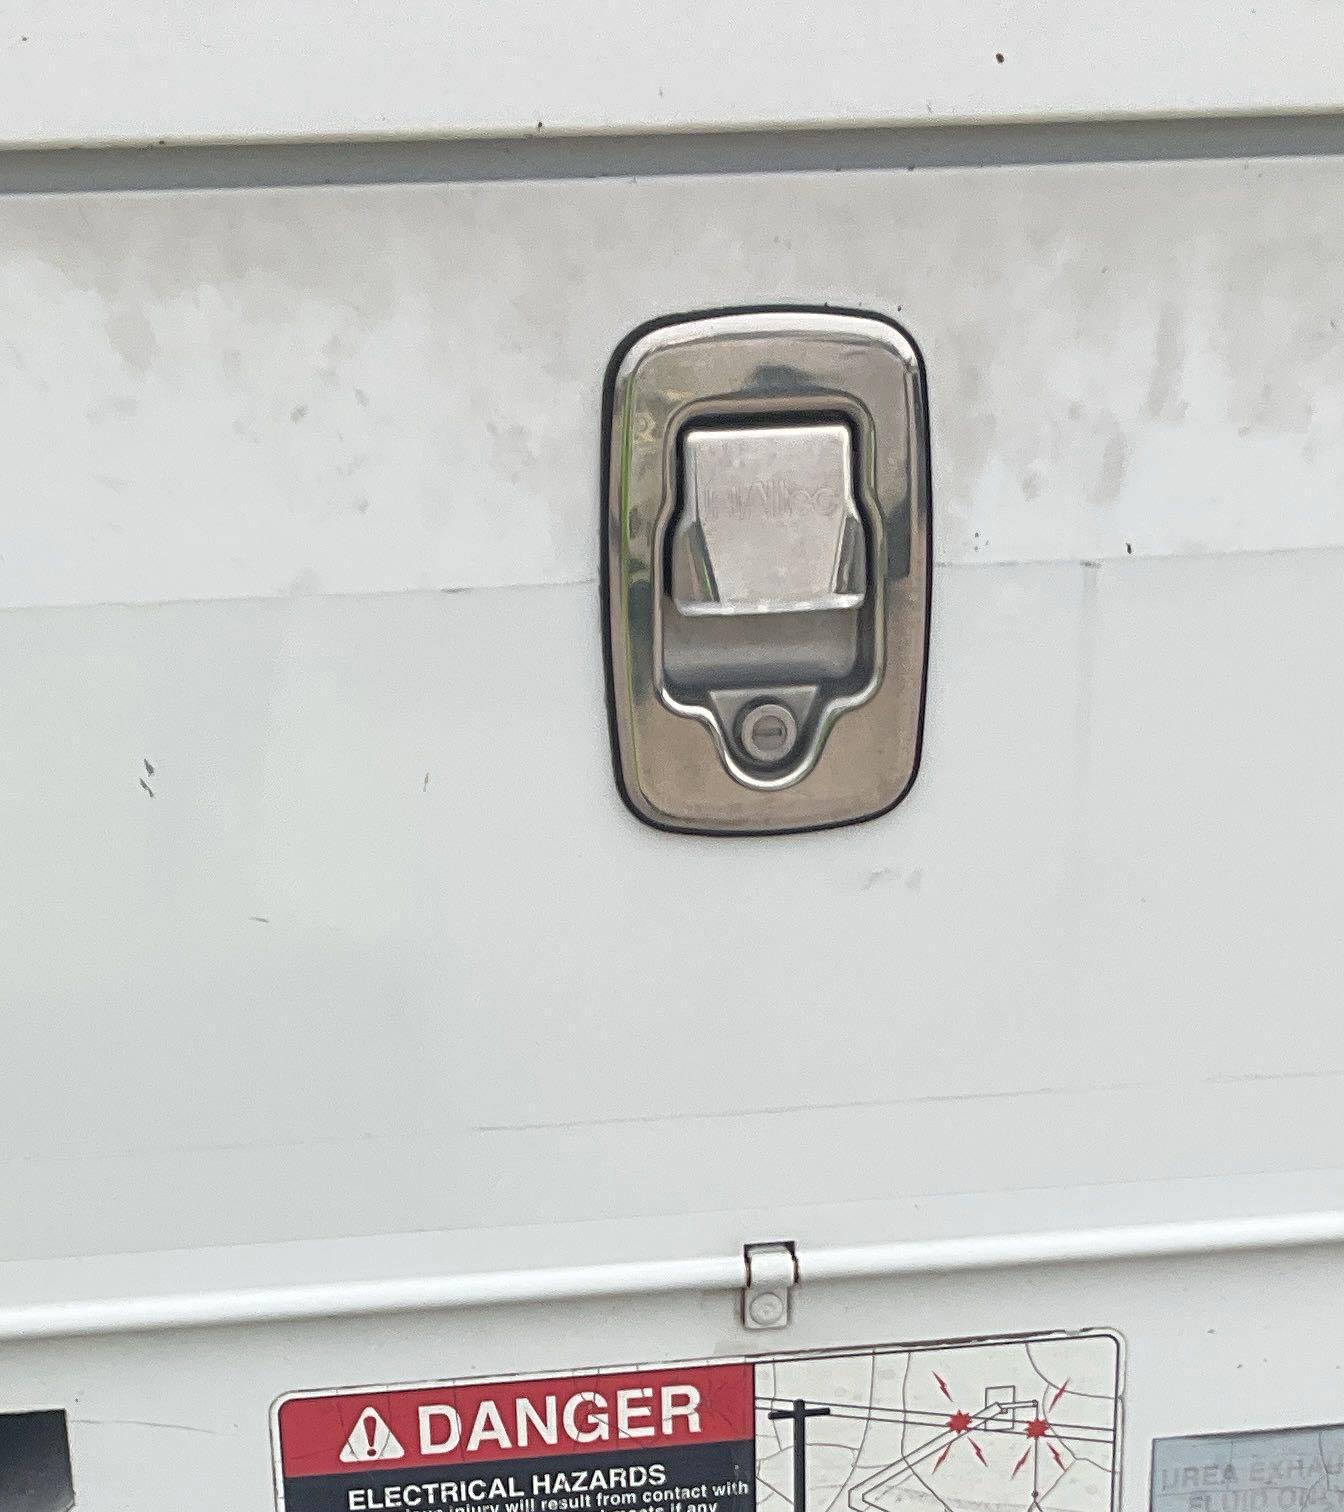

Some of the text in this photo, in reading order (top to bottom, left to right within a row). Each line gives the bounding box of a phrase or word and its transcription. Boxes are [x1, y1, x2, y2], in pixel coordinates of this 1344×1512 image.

[417, 1384, 702, 1456] DANGER
[347, 1463, 666, 1511] ELECTRICAL HAZARDS
[541, 1494, 591, 1512] result
[596, 1491, 637, 1507] from
[642, 1486, 707, 1503] contact
[712, 1480, 749, 1497] with
[1160, 1463, 1238, 1491] UREA
